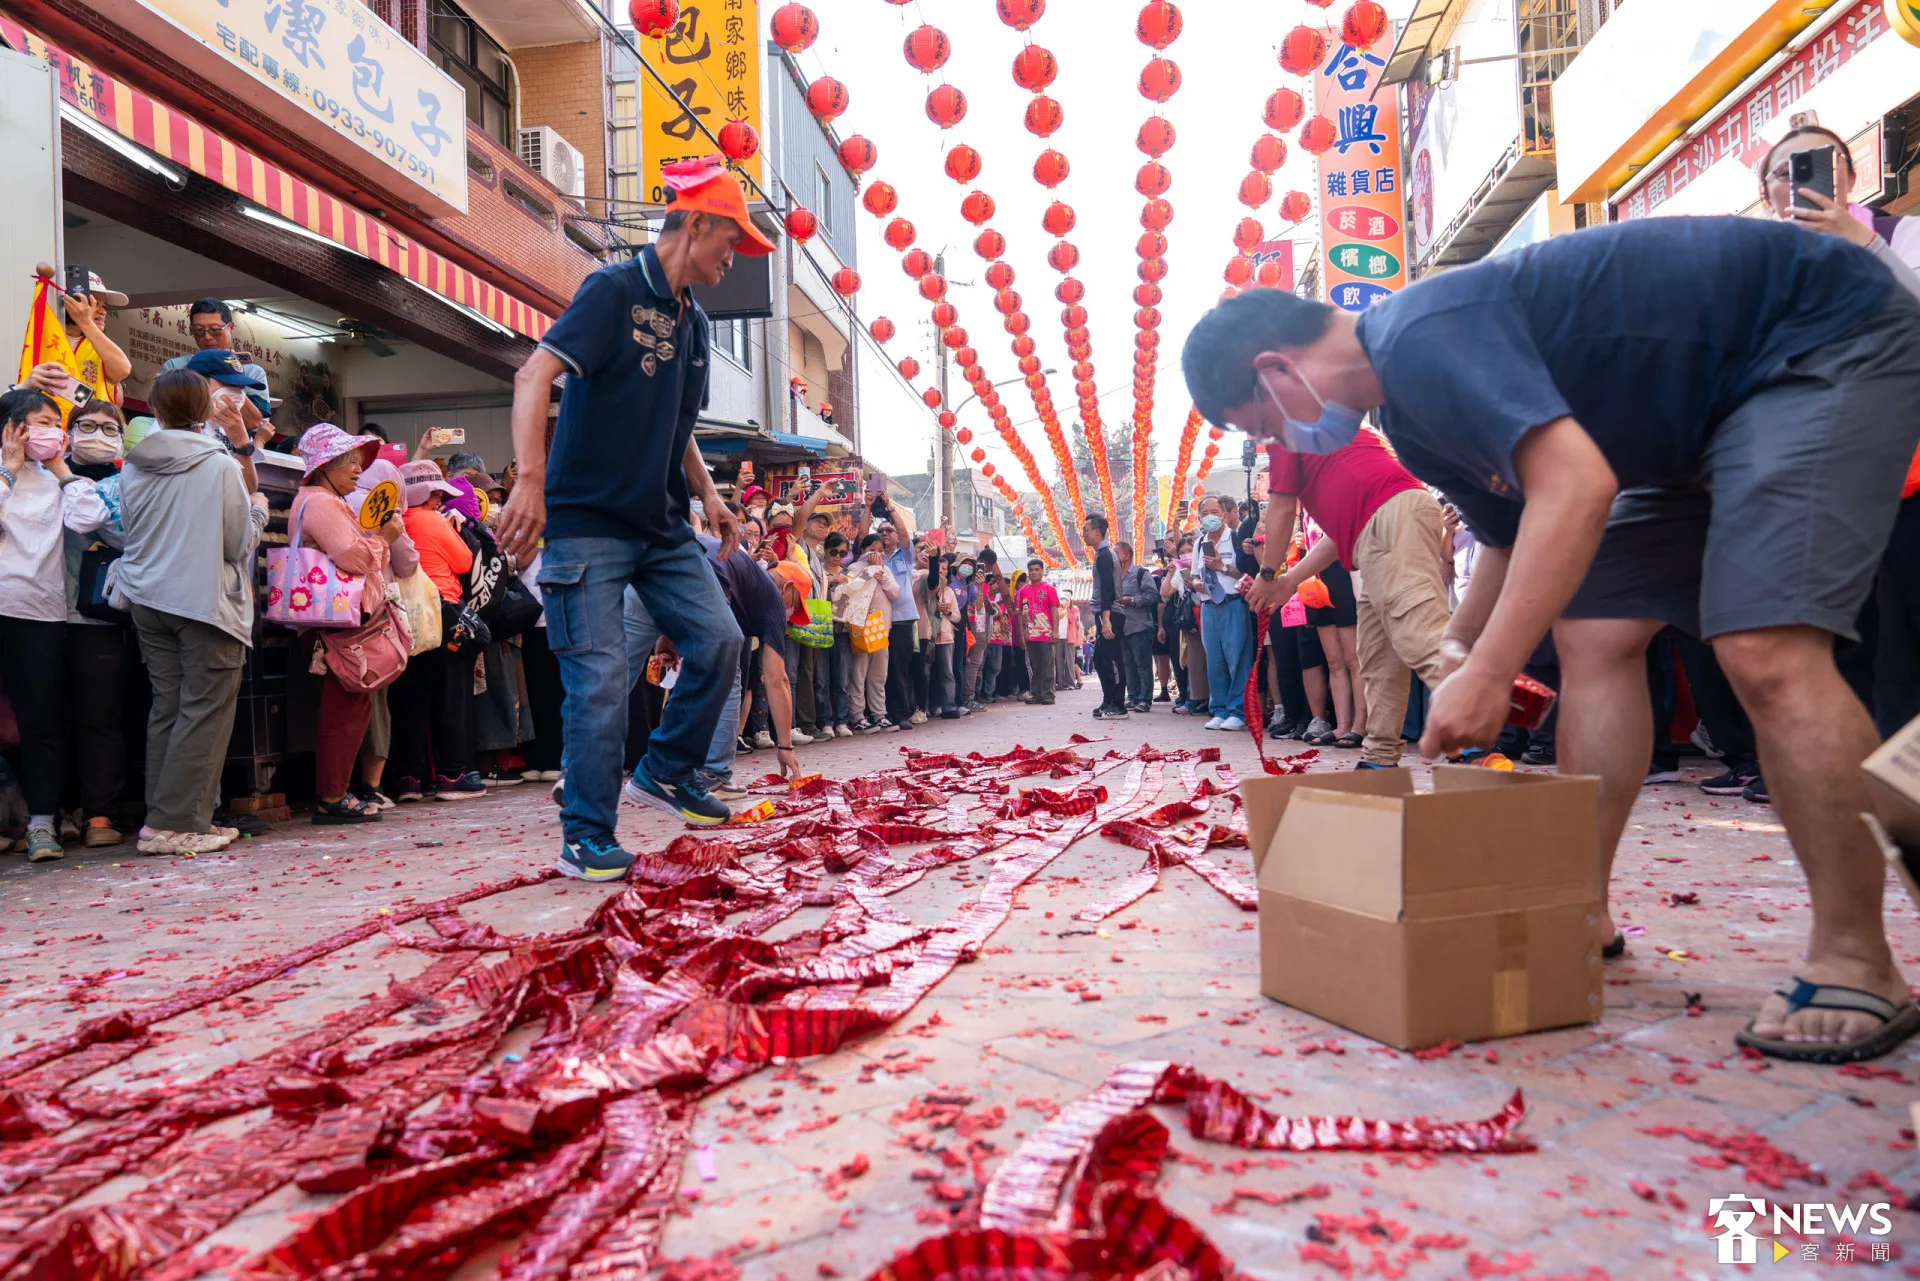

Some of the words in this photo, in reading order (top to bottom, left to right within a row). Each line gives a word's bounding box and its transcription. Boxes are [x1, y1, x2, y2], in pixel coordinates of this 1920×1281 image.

[216, 0, 453, 158] 潔包子
[1323, 44, 1387, 155] 合興
[1327, 167, 1395, 198] 雜貨店
[1339, 210, 1385, 237] 菸酒
[1340, 248, 1387, 275] 檳榔
